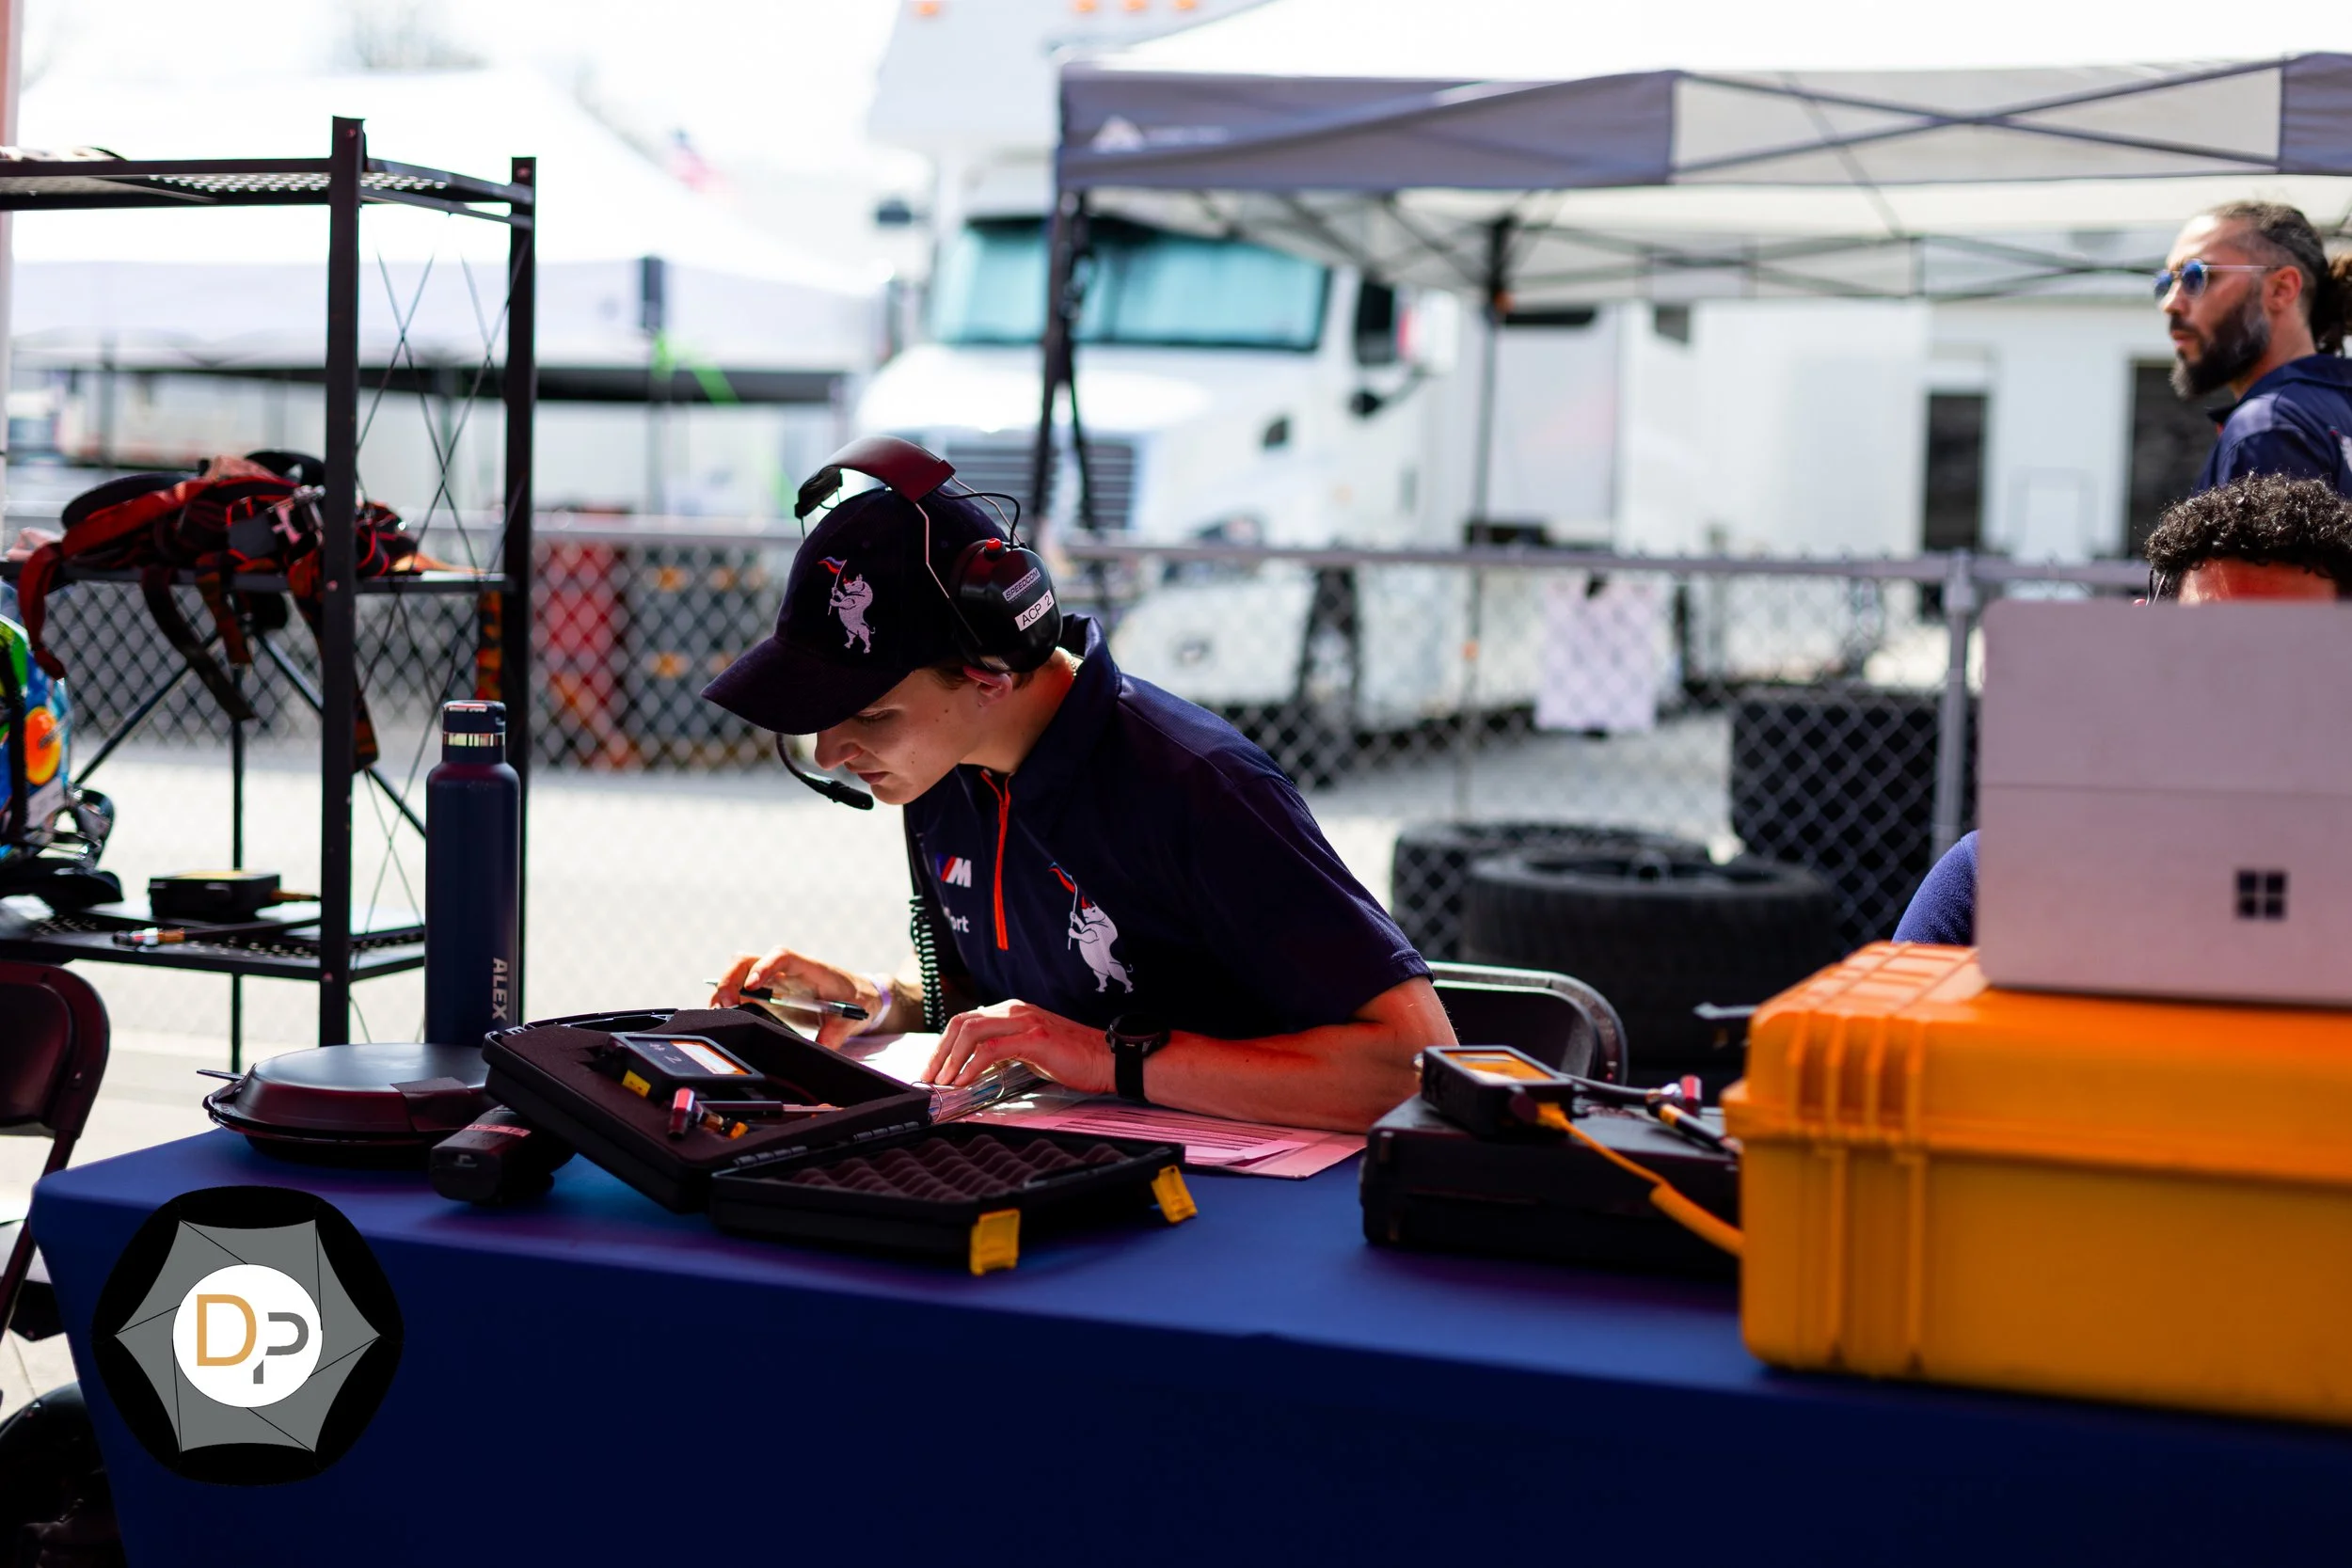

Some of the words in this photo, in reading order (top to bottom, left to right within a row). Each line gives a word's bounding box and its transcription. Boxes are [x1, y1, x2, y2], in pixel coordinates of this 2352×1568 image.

[1005, 569, 1040, 600] SPEEDCOM
[1021, 603, 1042, 626] ACP
[1044, 594, 1052, 607] 2
[492, 957, 508, 1021] ALEX
